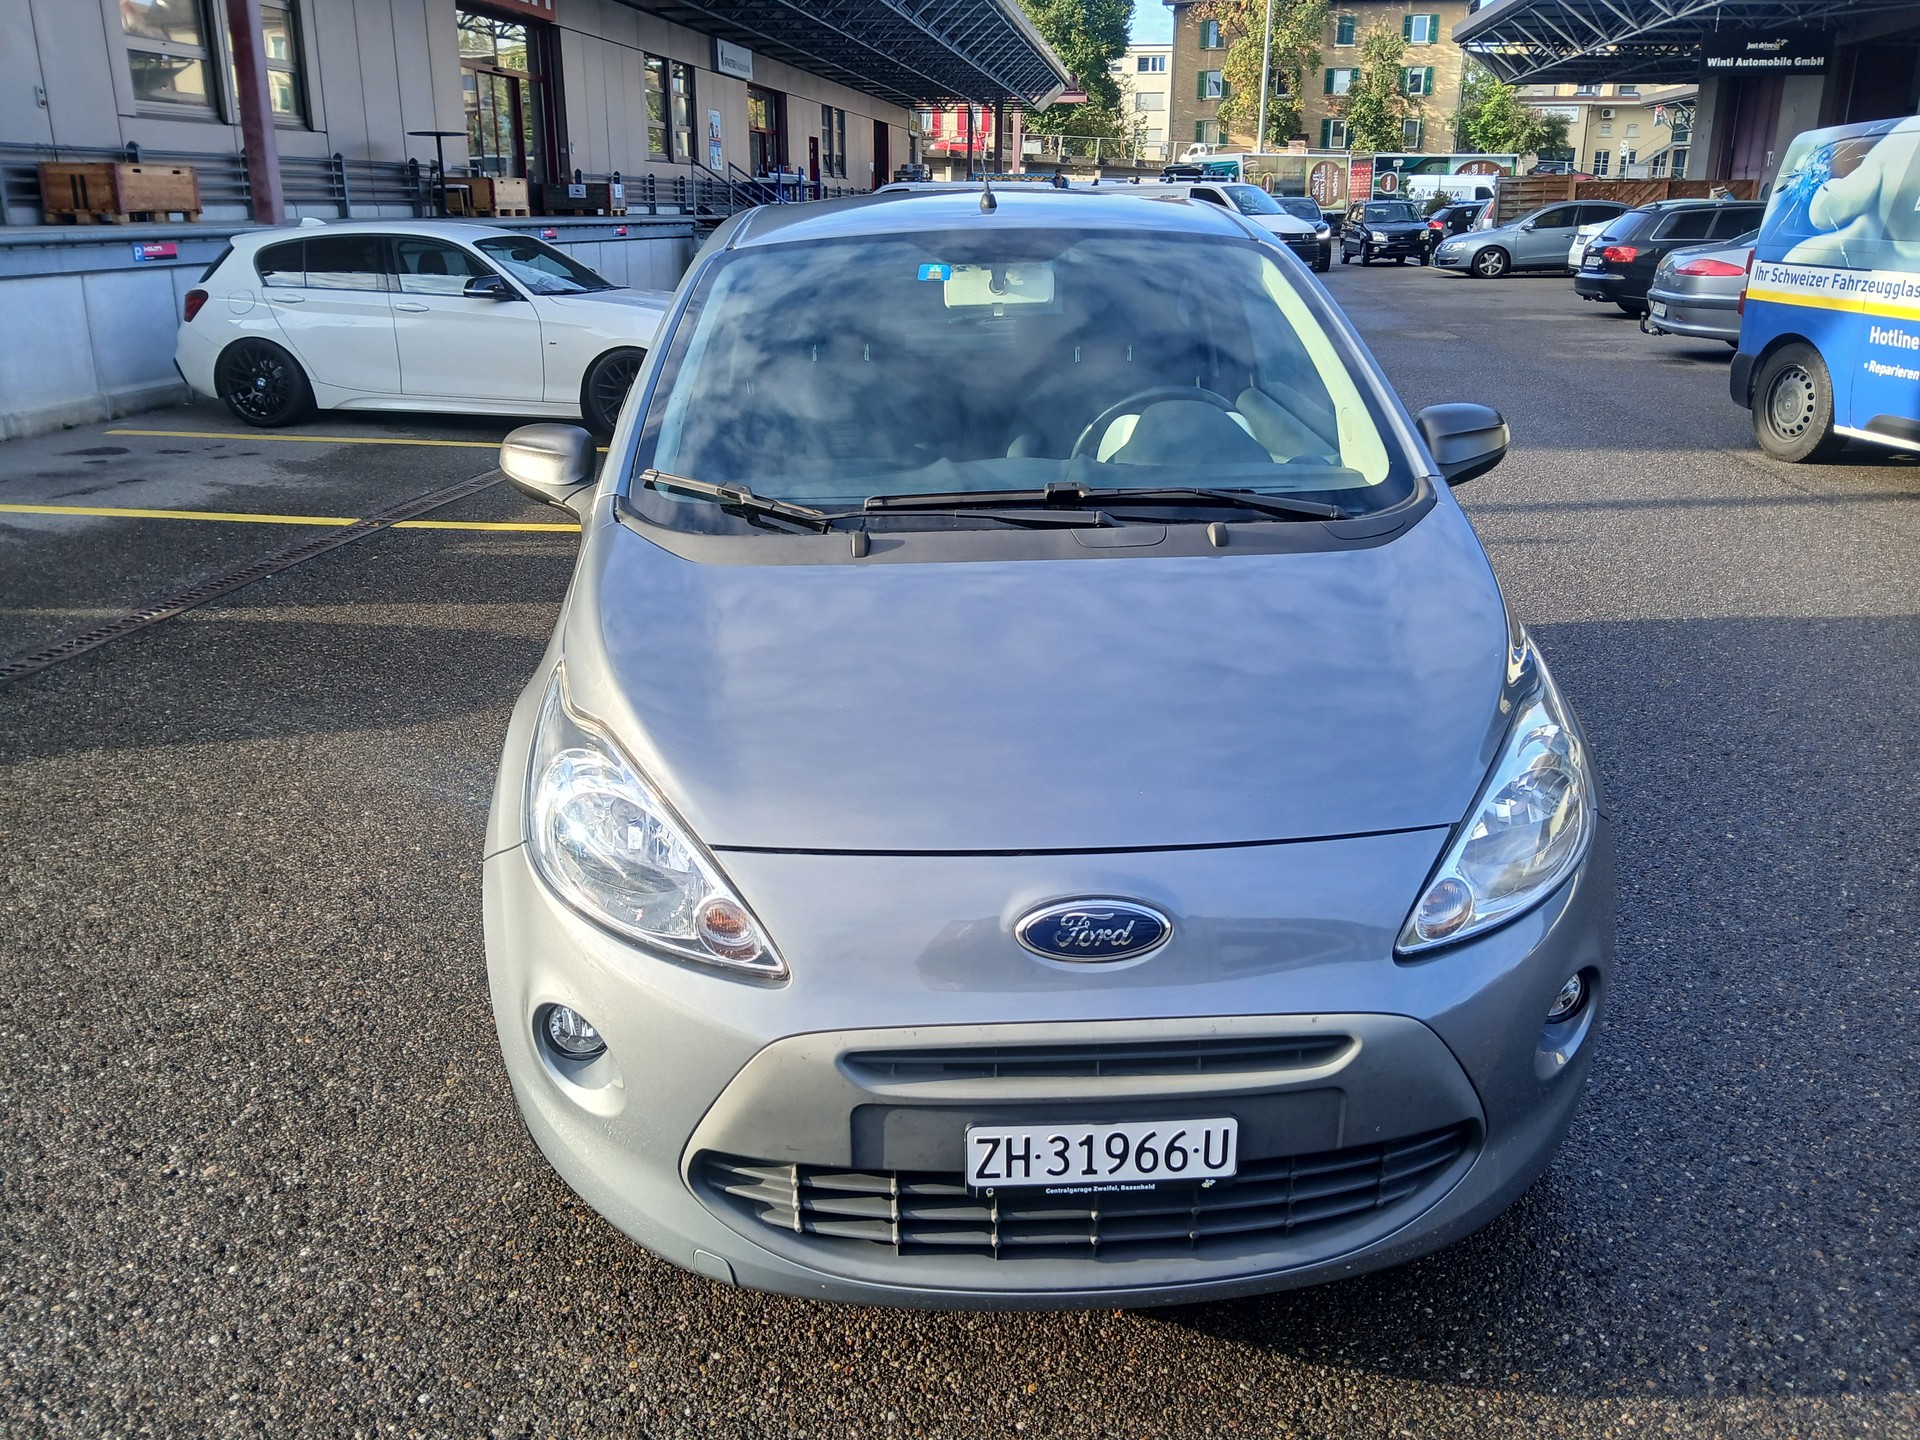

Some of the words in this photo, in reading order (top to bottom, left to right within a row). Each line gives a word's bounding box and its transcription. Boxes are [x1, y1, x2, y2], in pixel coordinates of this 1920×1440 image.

[1707, 57, 1734, 67] Winti
[1735, 56, 1792, 67] Automobile
[1794, 56, 1824, 66] GmbH
[1754, 266, 1769, 281] Ihr
[1770, 267, 1830, 289] Schweizer
[1831, 273, 1920, 300] Fahrzeugglas
[1869, 326, 1920, 350] Hotline
[1868, 360, 1920, 380] Reparieren
[1055, 912, 1135, 947] Ford
[1045, 1186, 1092, 1195] Centralgarage
[1120, 1183, 1156, 1191] Bazenheid
